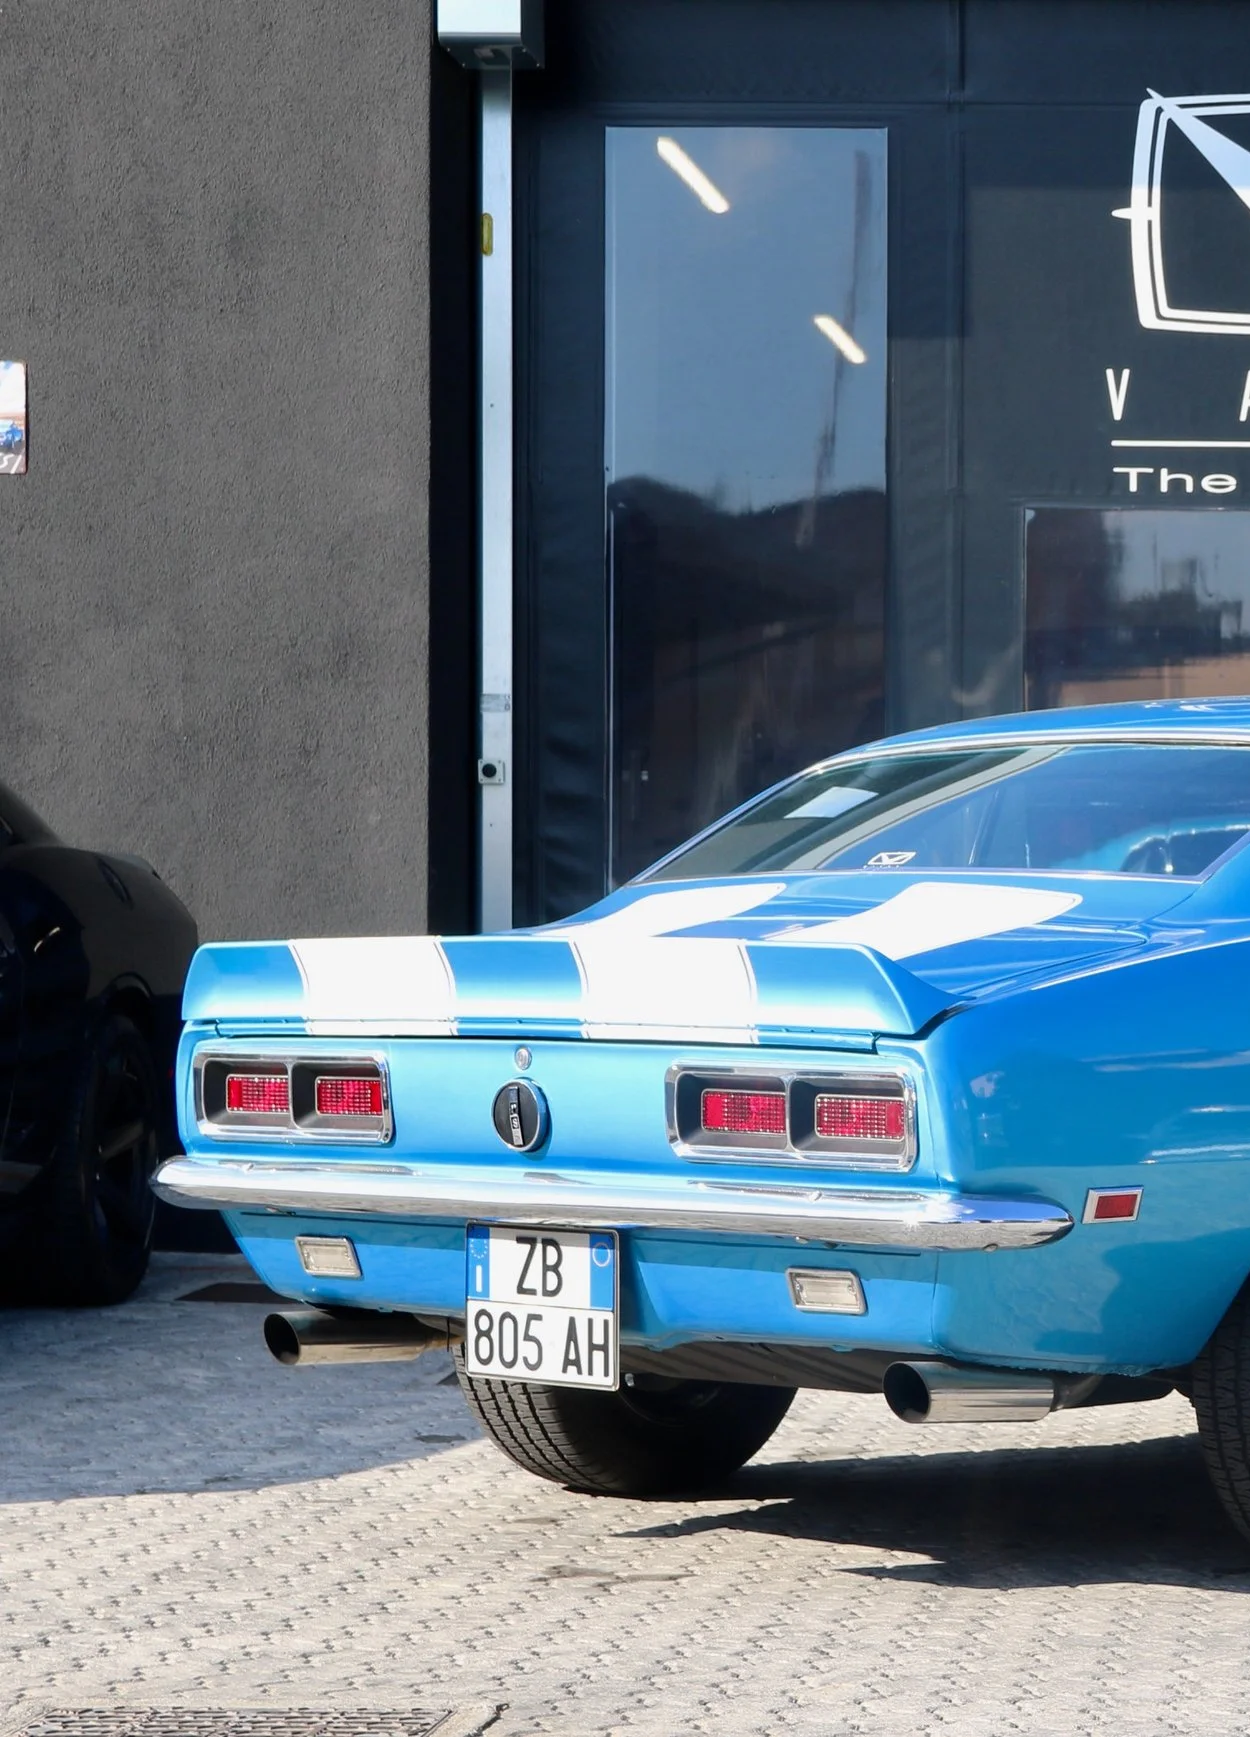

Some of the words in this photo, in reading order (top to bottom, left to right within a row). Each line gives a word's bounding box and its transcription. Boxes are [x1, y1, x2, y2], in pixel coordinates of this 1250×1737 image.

[1112, 466, 1238, 494] The
[515, 1236, 563, 1298] ZB
[474, 1308, 543, 1371] 805
[561, 1315, 610, 1378] AH
